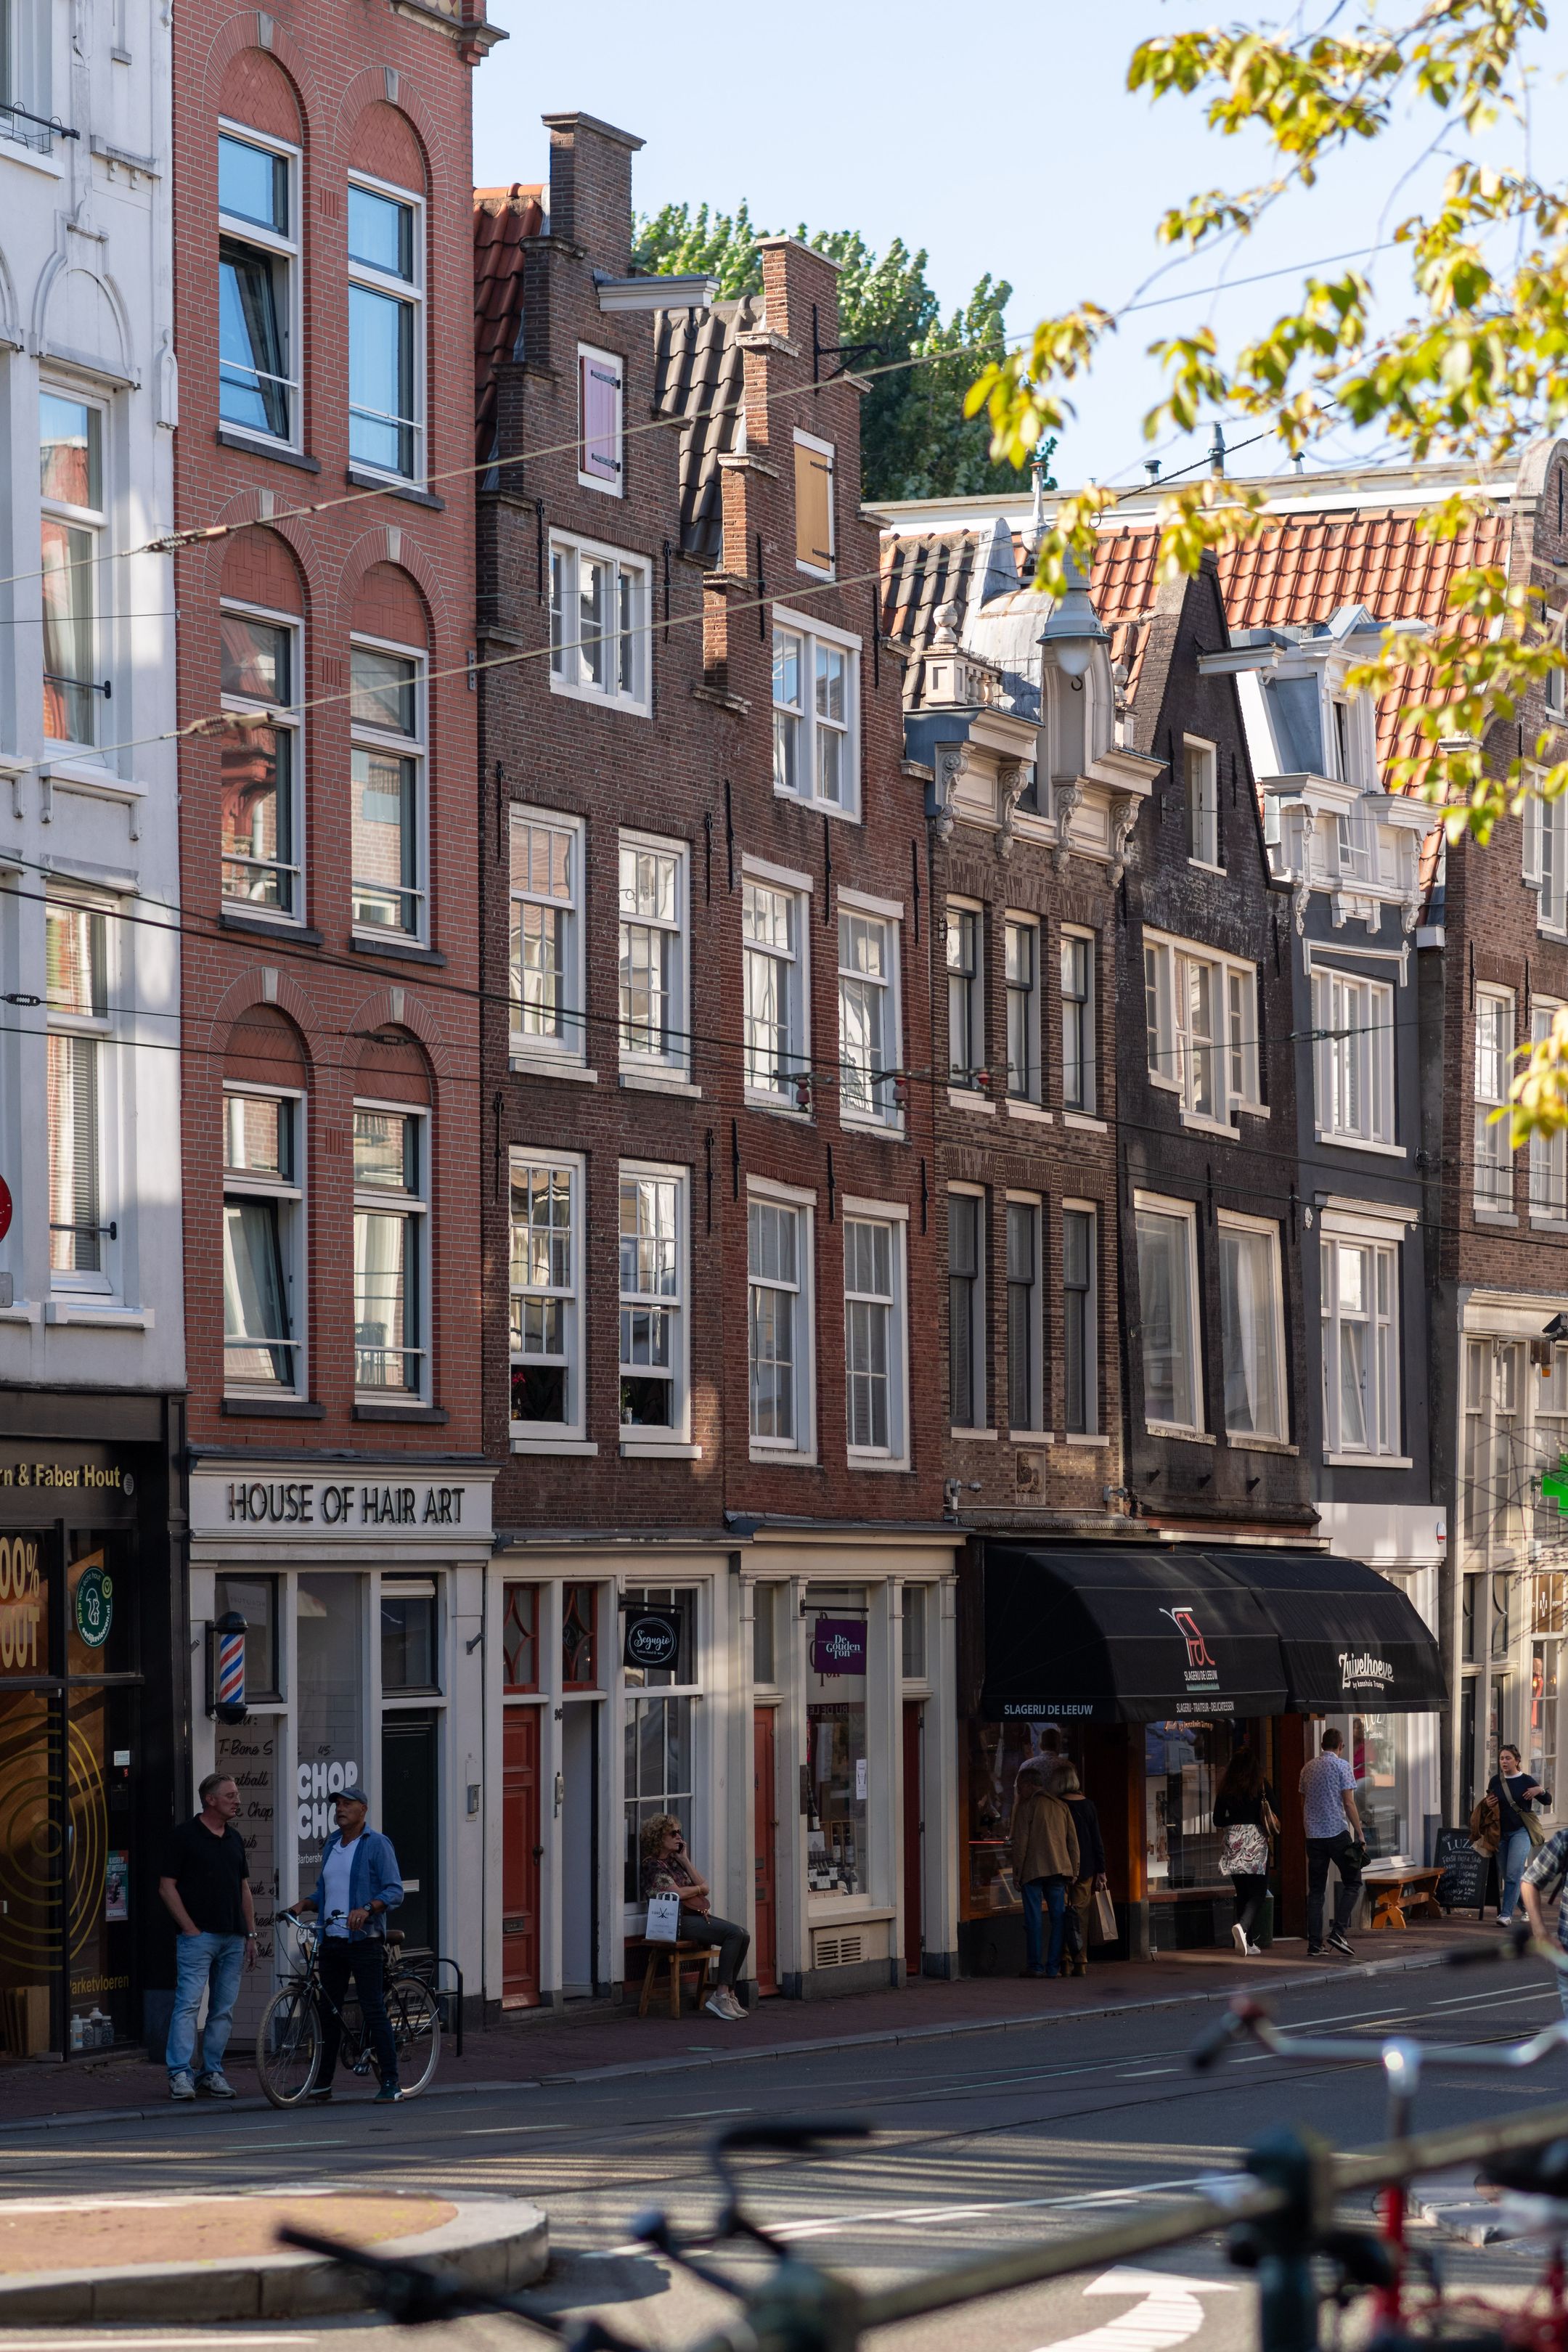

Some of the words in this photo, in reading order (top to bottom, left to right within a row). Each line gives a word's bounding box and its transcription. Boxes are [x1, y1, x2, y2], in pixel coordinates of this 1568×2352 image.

[18, 1463, 30, 1486] &
[36, 1464, 80, 1487] Faber
[84, 1464, 121, 1487] Hout
[229, 1483, 314, 1522] HOUSE
[322, 1486, 355, 1523] OF
[363, 1486, 416, 1524] HAIR
[423, 1487, 465, 1523] ART
[634, 1629, 671, 1651] Segugio
[825, 1641, 860, 1653] Gouden
[835, 1634, 847, 1644] De
[834, 1650, 850, 1659] Ton
[1338, 1652, 1395, 1690] Zuivelhoeve
[1352, 1681, 1357, 1690] by
[1004, 1704, 1045, 1715] SLAGERIJ
[1048, 1704, 1060, 1715] DE
[1062, 1704, 1093, 1715] LEEUW
[1176, 1703, 1191, 1712] SLAGERIJ
[1193, 1702, 1209, 1712] TRAITEUR
[1211, 1702, 1234, 1712] DELICATESSEN
[219, 1739, 259, 1755] T-Bone
[298, 1761, 358, 1800] CHOP
[298, 1802, 340, 1840] CHO
[70, 1975, 129, 1995] arketvloeren
